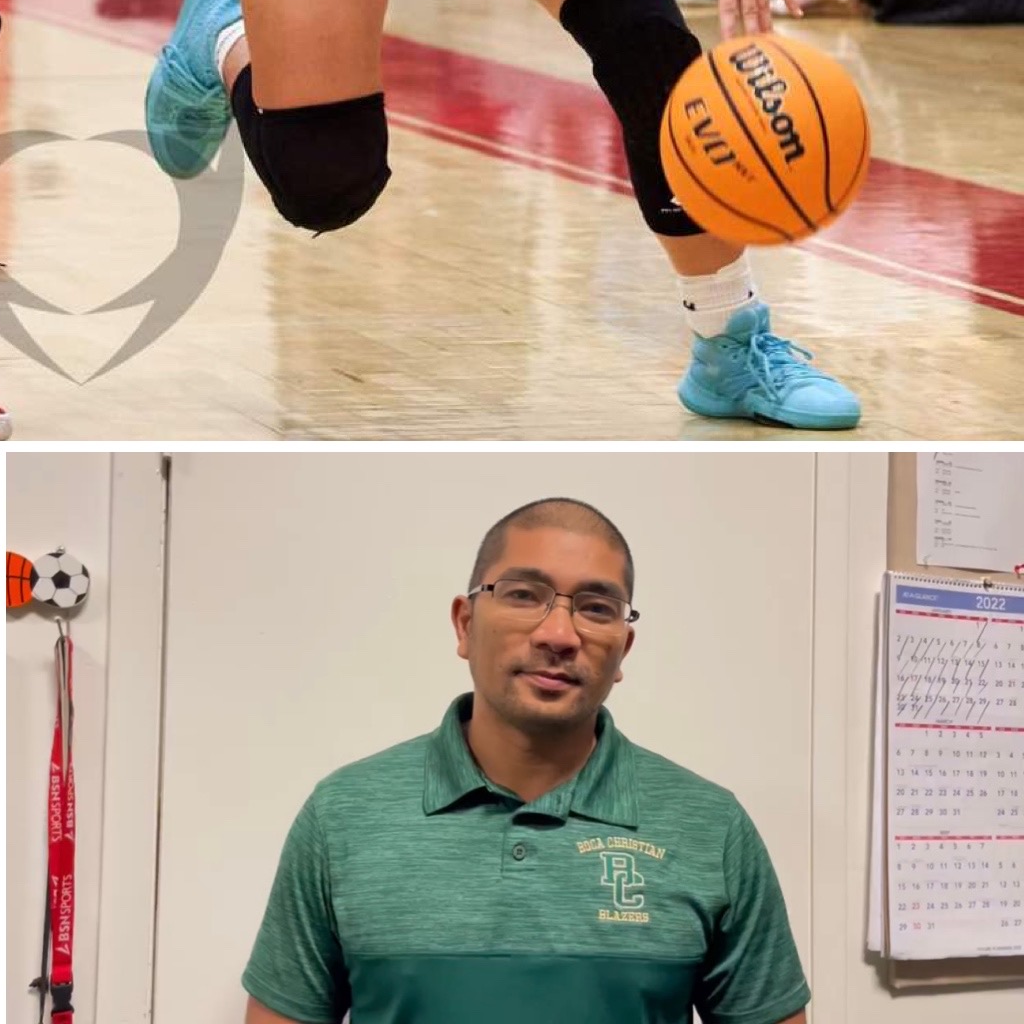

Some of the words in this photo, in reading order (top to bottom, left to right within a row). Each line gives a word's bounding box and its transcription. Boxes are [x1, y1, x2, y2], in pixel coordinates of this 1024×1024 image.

[729, 43, 805, 163] Wilson
[976, 596, 1007, 610] 2022
[577, 837, 605, 854] BOCA
[606, 836, 667, 860] CHRISTIAN
[598, 909, 650, 923] BLAZERS
